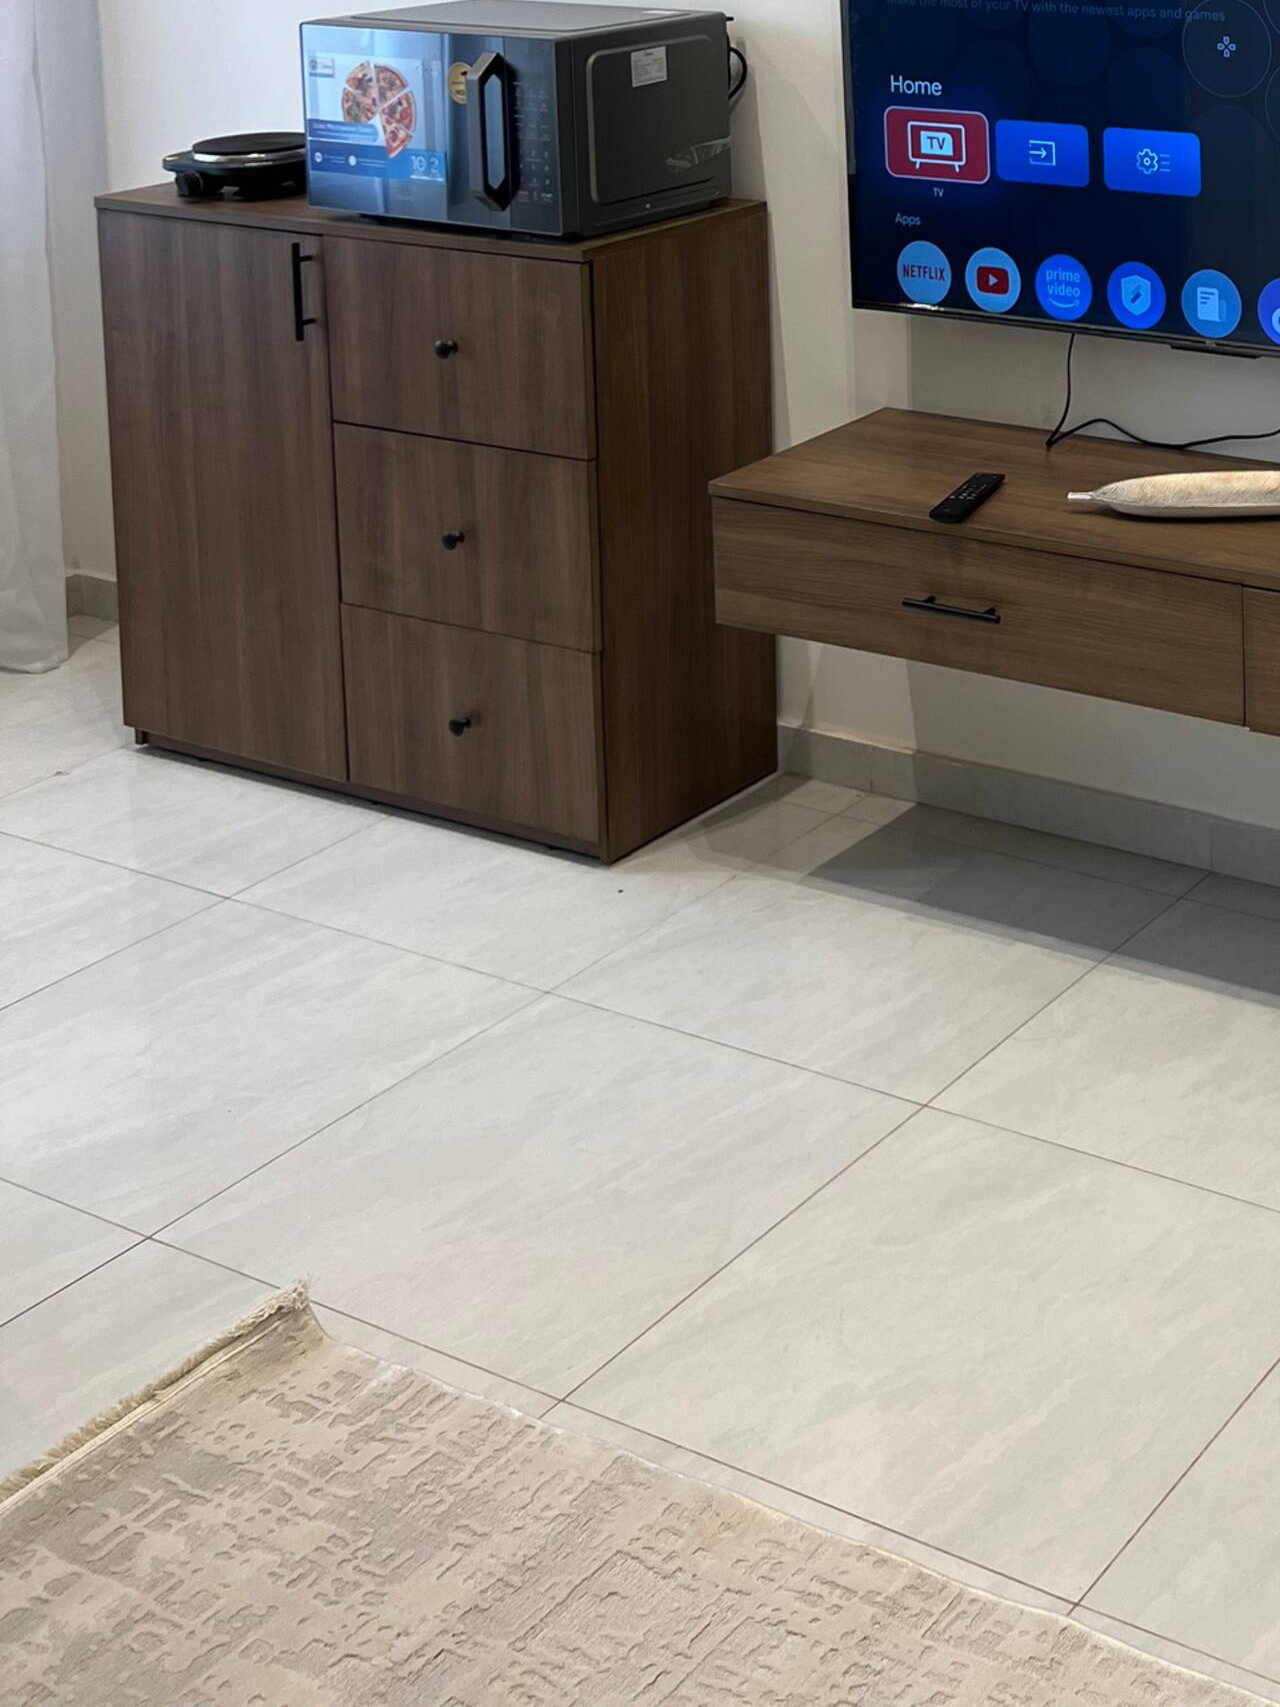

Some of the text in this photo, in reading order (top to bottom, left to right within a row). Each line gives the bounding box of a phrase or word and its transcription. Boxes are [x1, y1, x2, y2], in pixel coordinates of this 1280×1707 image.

[985, 0, 1010, 11] your
[1013, 0, 1029, 11] TV
[1032, 0, 1057, 13] with
[1059, 2, 1079, 14] the
[1081, 4, 1125, 16] newest
[1127, 7, 1157, 20] apps
[1159, 7, 1182, 19] and
[1184, 10, 1225, 23] games
[890, 75, 942, 96] Home
[926, 136, 946, 151] TV
[933, 187, 944, 197] TV
[895, 212, 921, 227] Apps
[902, 264, 946, 282] NETFLIX
[1045, 268, 1081, 283] prime
[1047, 282, 1081, 297] video
